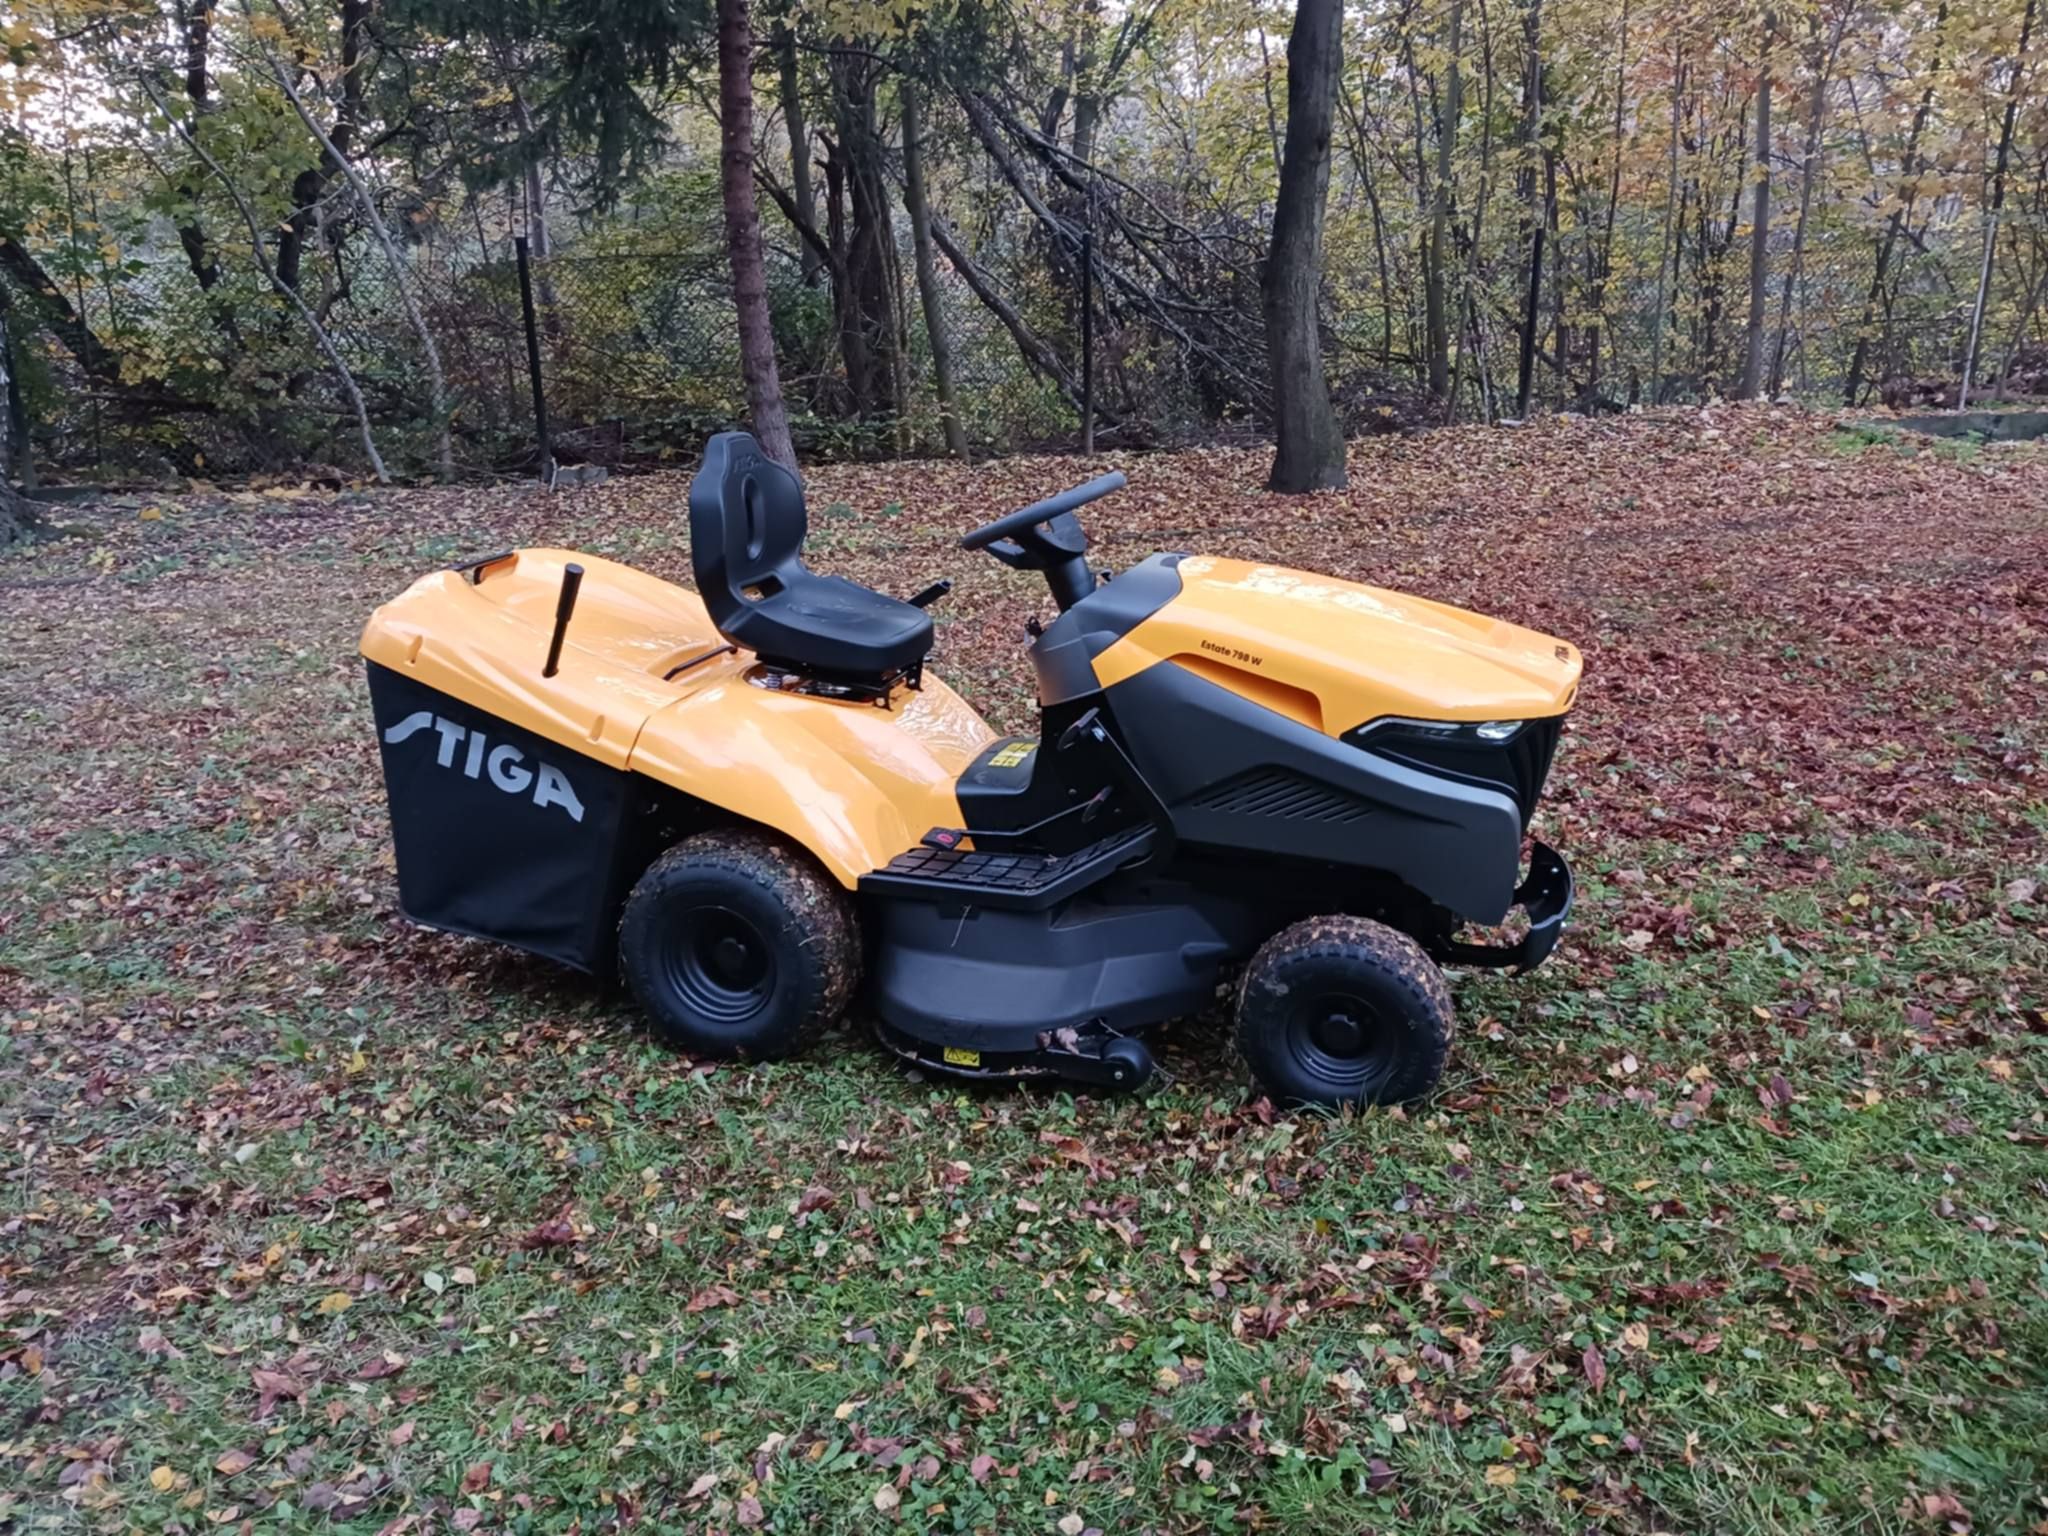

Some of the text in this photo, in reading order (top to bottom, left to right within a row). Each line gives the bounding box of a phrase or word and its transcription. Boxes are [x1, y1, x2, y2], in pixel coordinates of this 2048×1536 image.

[1201, 640, 1263, 666] Estate 798 W
[384, 711, 585, 822] STIGA
